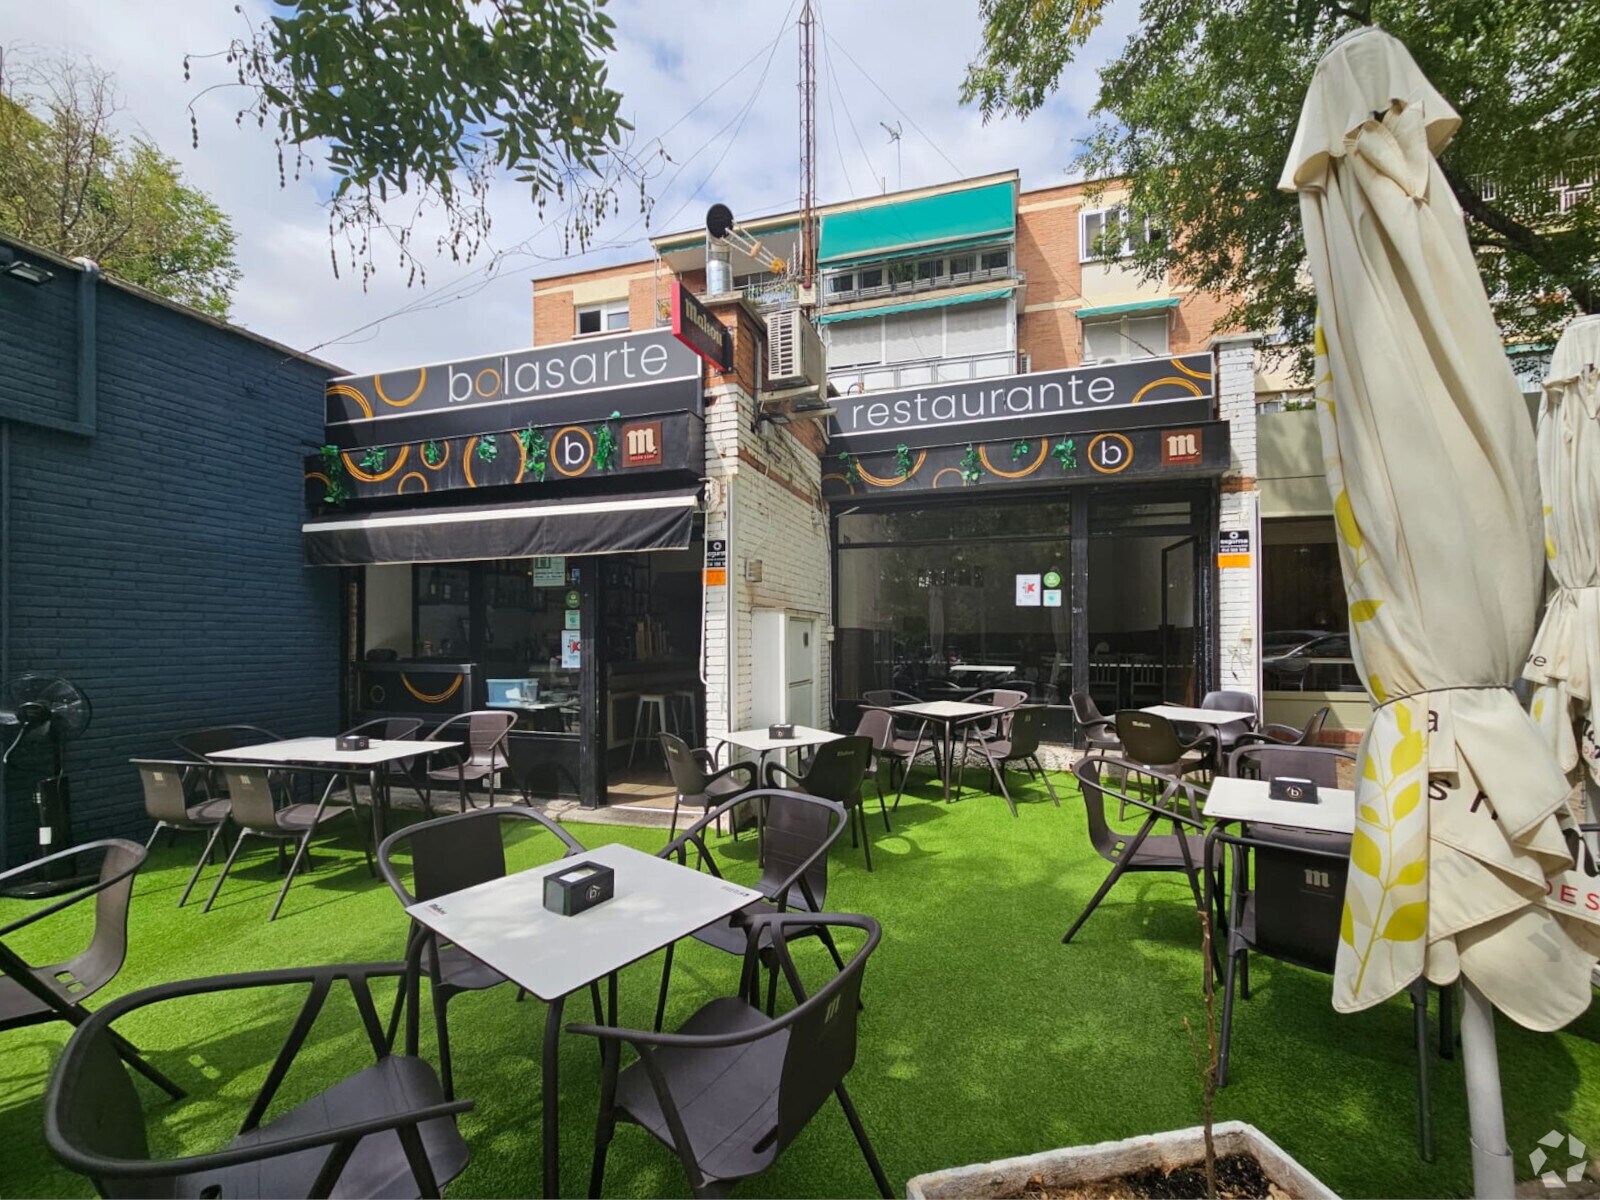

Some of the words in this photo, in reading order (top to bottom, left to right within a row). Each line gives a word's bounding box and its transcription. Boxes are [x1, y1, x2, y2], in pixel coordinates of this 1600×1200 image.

[448, 341, 668, 402] bolasarte
[853, 374, 1115, 428] restaurante
[565, 436, 585, 465] b
[1102, 440, 1122, 465] b
